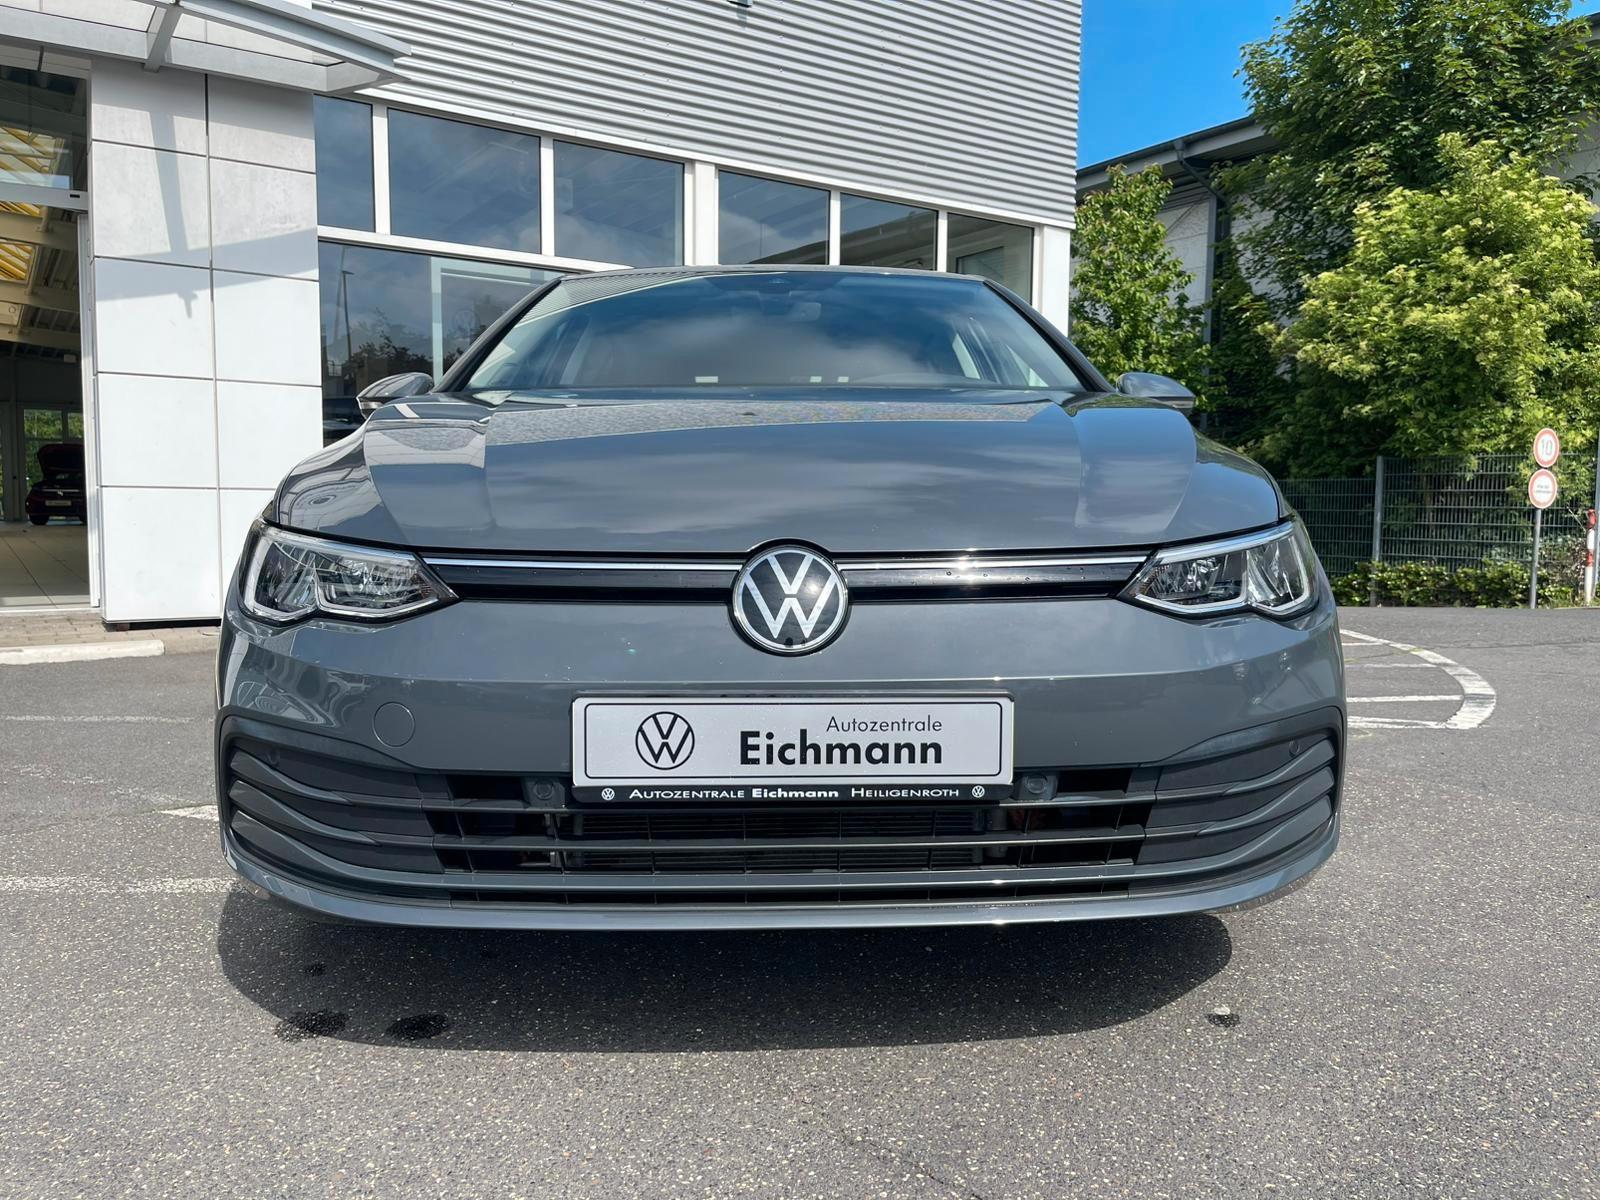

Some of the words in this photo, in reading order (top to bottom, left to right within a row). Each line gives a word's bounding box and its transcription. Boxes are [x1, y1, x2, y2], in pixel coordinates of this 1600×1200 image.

[1540, 439, 1553, 456] 10
[735, 549, 845, 649] VW
[826, 714, 943, 733] Autozentrale
[635, 711, 695, 770] VW
[740, 728, 943, 766] Eichmann
[629, 788, 745, 800] AUTOZENTRALE
[752, 787, 839, 799] Eichmann
[851, 786, 960, 799] HEILIGENROTH
